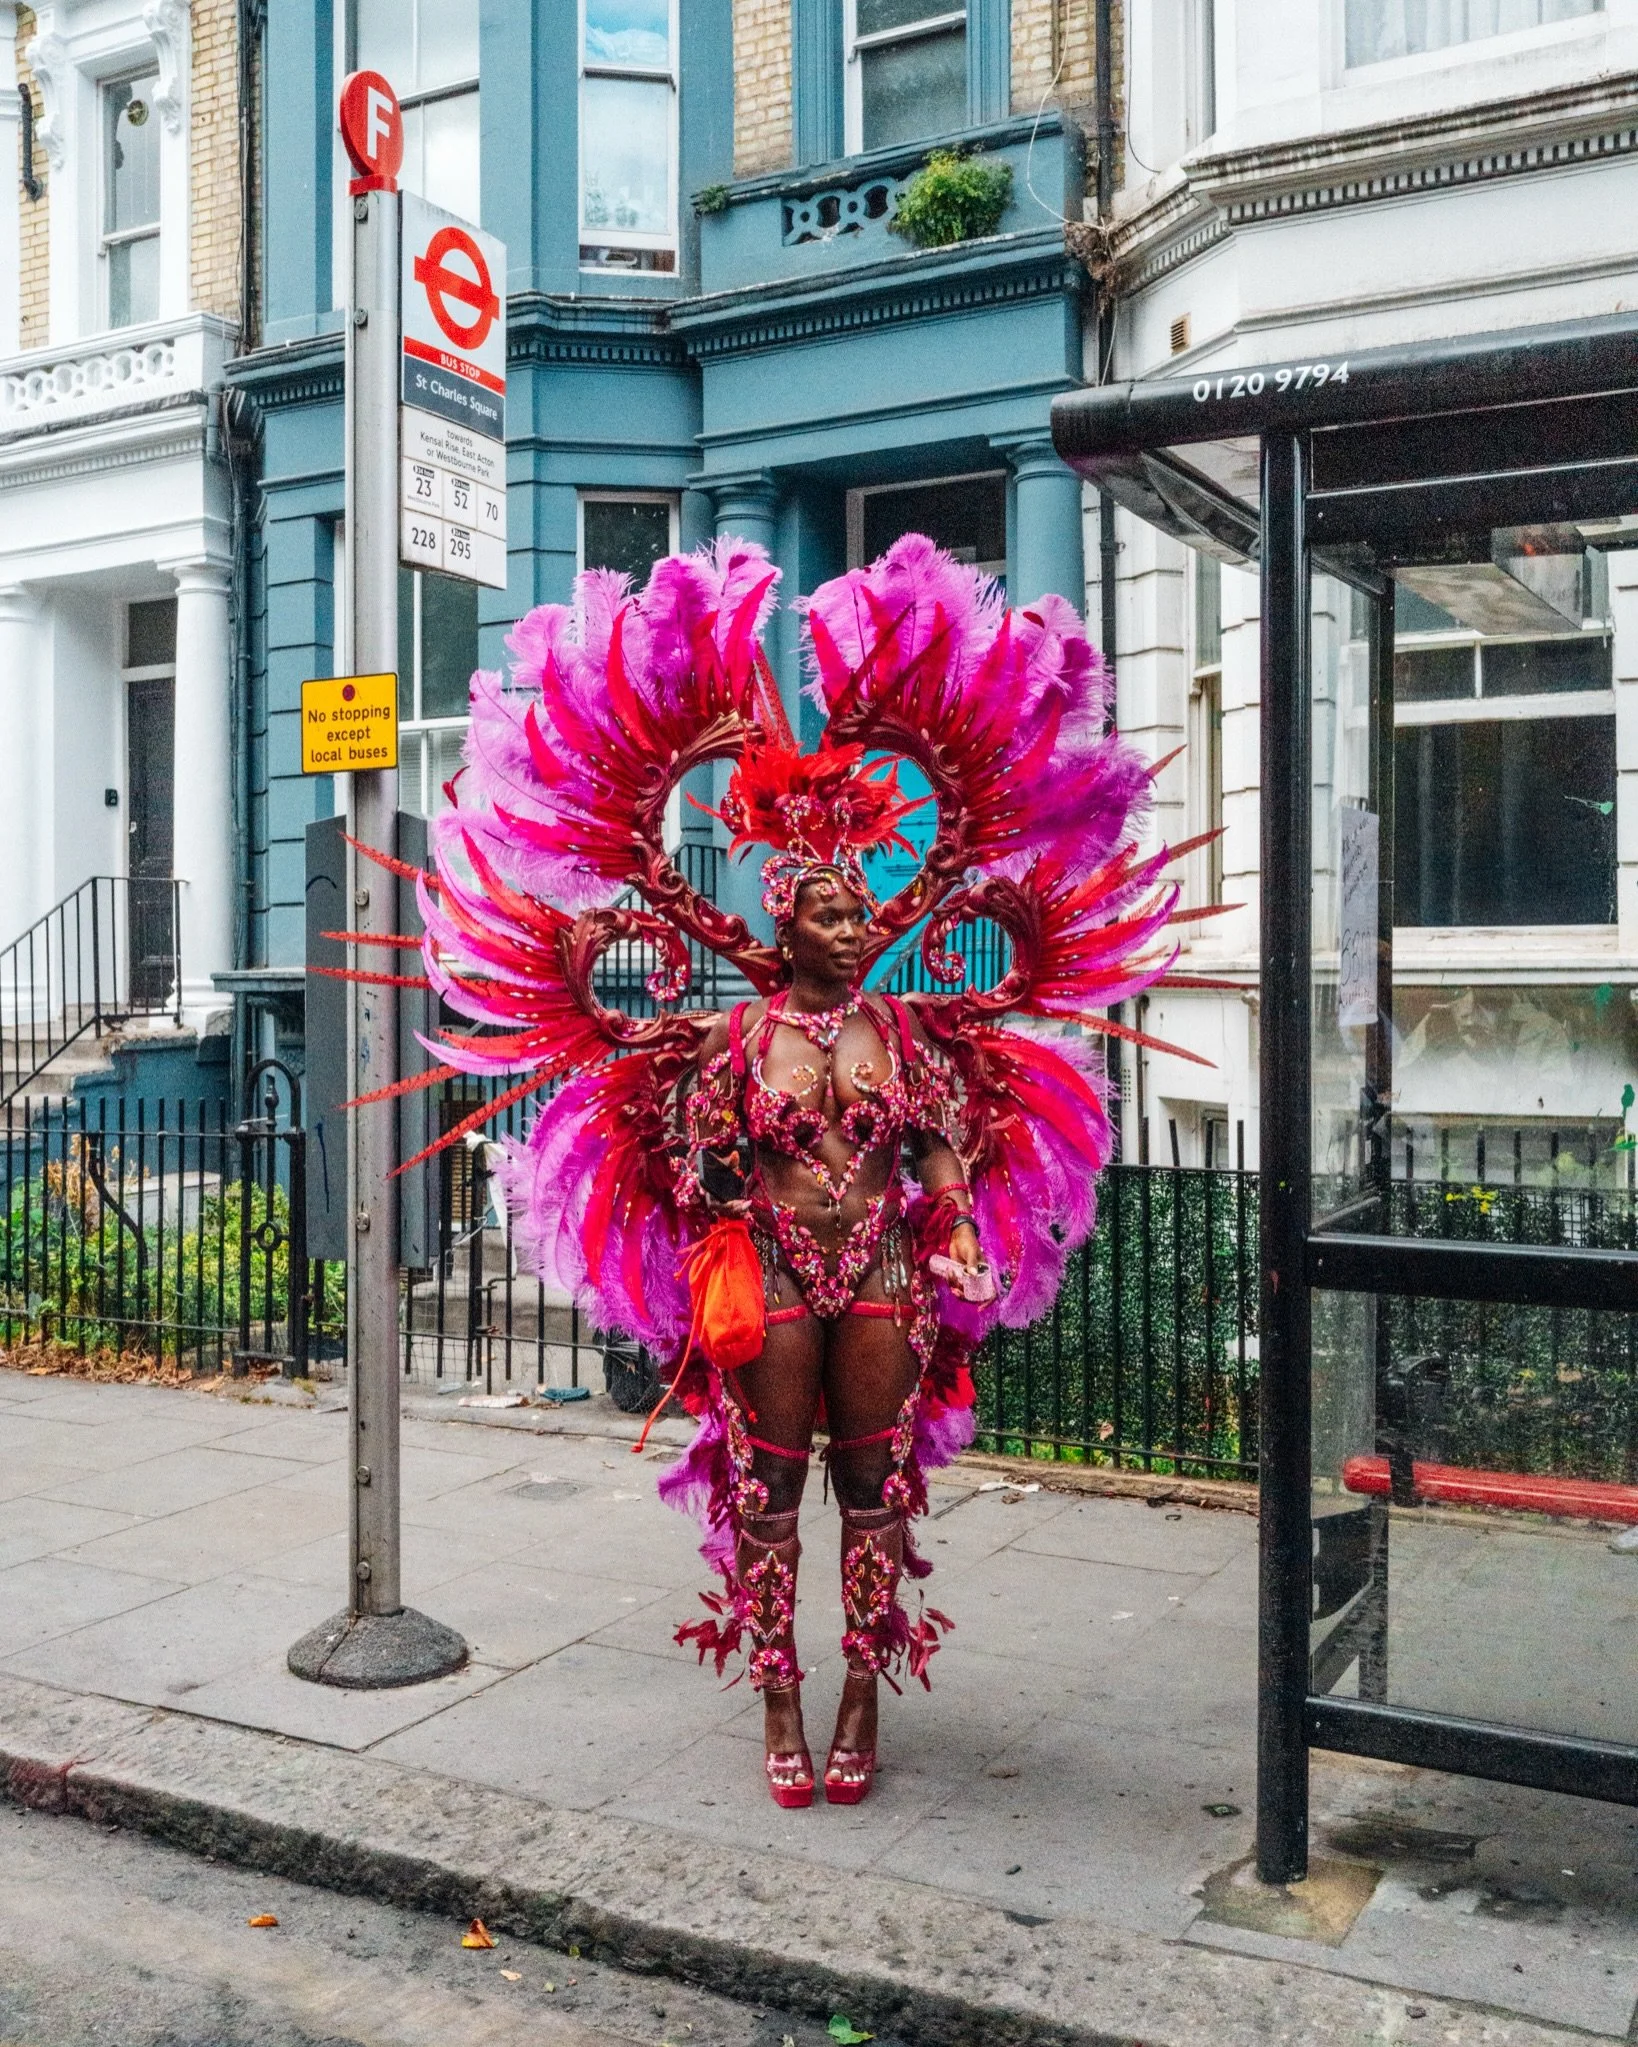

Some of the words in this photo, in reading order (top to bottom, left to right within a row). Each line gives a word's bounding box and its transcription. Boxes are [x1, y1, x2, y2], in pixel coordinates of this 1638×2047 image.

[366, 85, 393, 160] F
[440, 353, 458, 369] BUS
[460, 362, 480, 379] STOP
[1192, 372, 1265, 402] 0120
[1275, 361, 1350, 392] 9794
[415, 374, 428, 390] St
[430, 380, 468, 406] Charles
[469, 396, 498, 421] Square
[447, 429, 473, 447] towards
[420, 431, 444, 448] Kensal
[462, 446, 476, 460] East
[477, 453, 495, 469] Acton
[426, 448, 434, 457] or
[436, 449, 476, 473] Westbourne
[477, 466, 489, 478] Park
[416, 477, 432, 497] 23
[454, 490, 468, 510] 52
[486, 501, 498, 521] 70
[412, 527, 436, 550] 228
[450, 538, 471, 560] 295
[308, 709, 326, 723] No
[332, 704, 390, 722] stopping
[327, 726, 371, 742] except
[311, 747, 342, 763] local
[349, 746, 388, 760] buses
